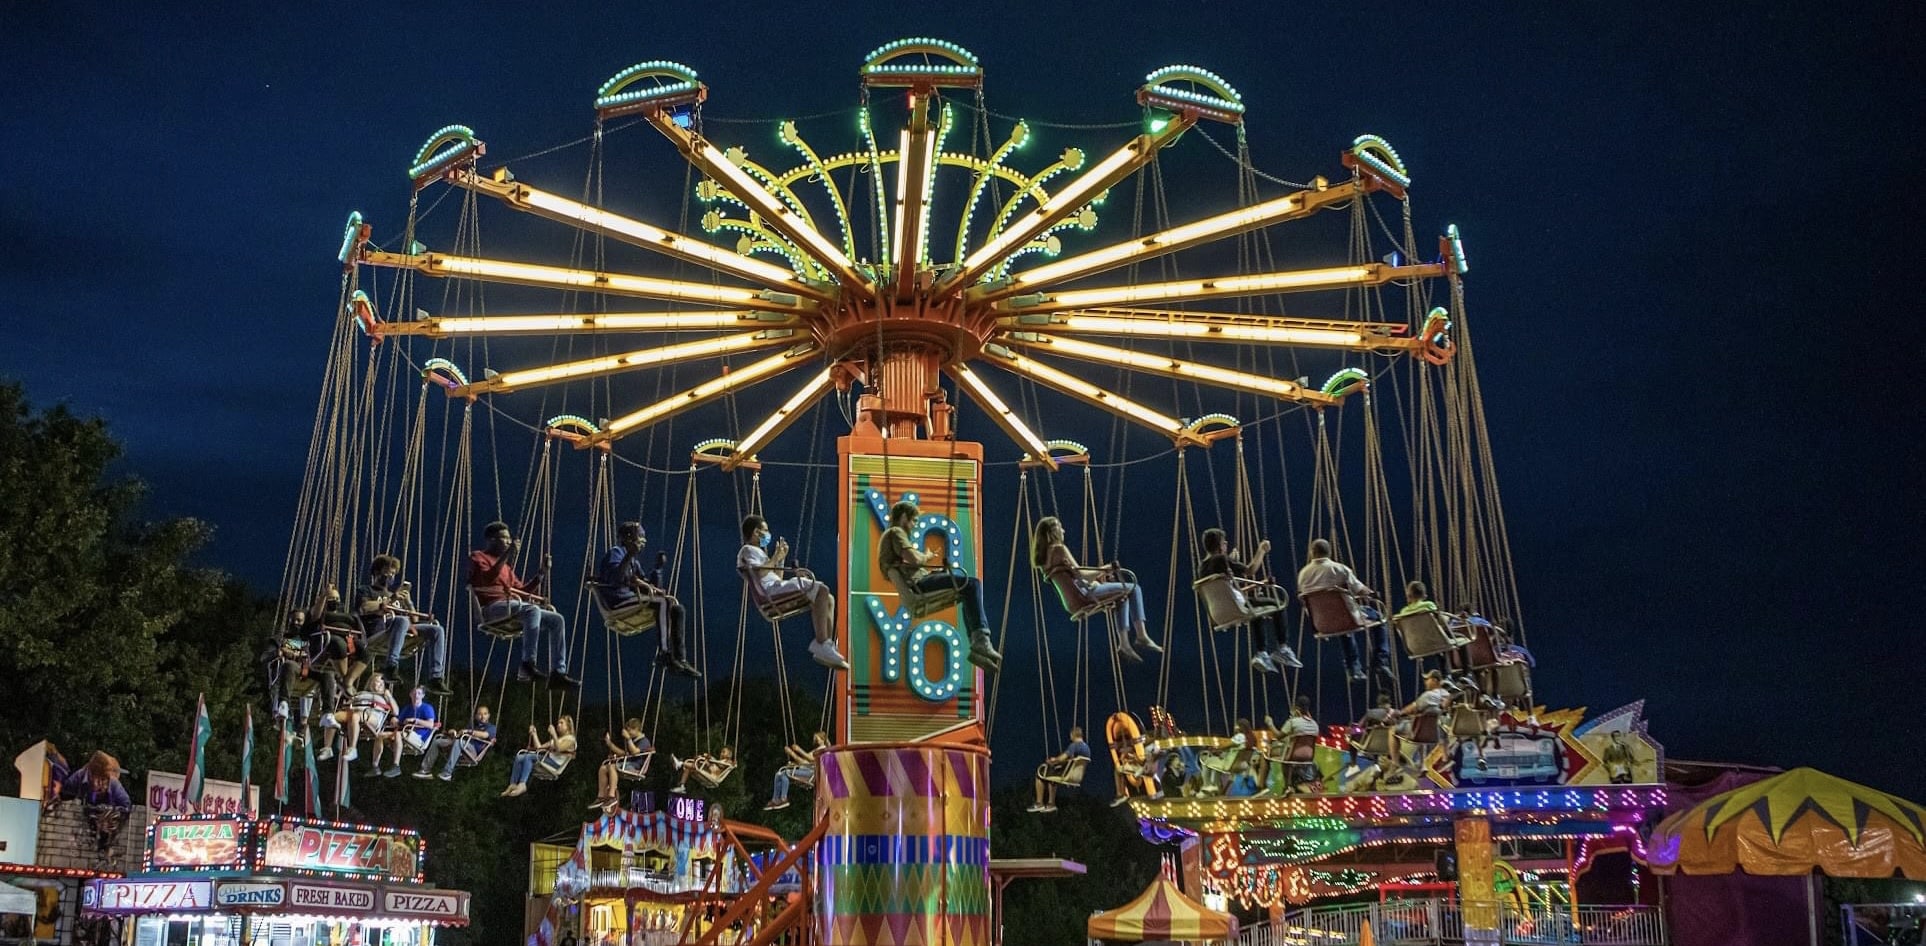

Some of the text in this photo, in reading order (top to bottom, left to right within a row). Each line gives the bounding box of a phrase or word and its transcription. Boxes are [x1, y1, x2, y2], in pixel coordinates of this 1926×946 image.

[864, 595, 964, 702] YO
[161, 824, 234, 840] PIZZA
[296, 827, 391, 872] PIZZA
[115, 882, 199, 908] PIZZA
[226, 888, 281, 904] DRINKS
[295, 888, 370, 908] FRESH BAKED
[392, 894, 450, 913] PIZZA
